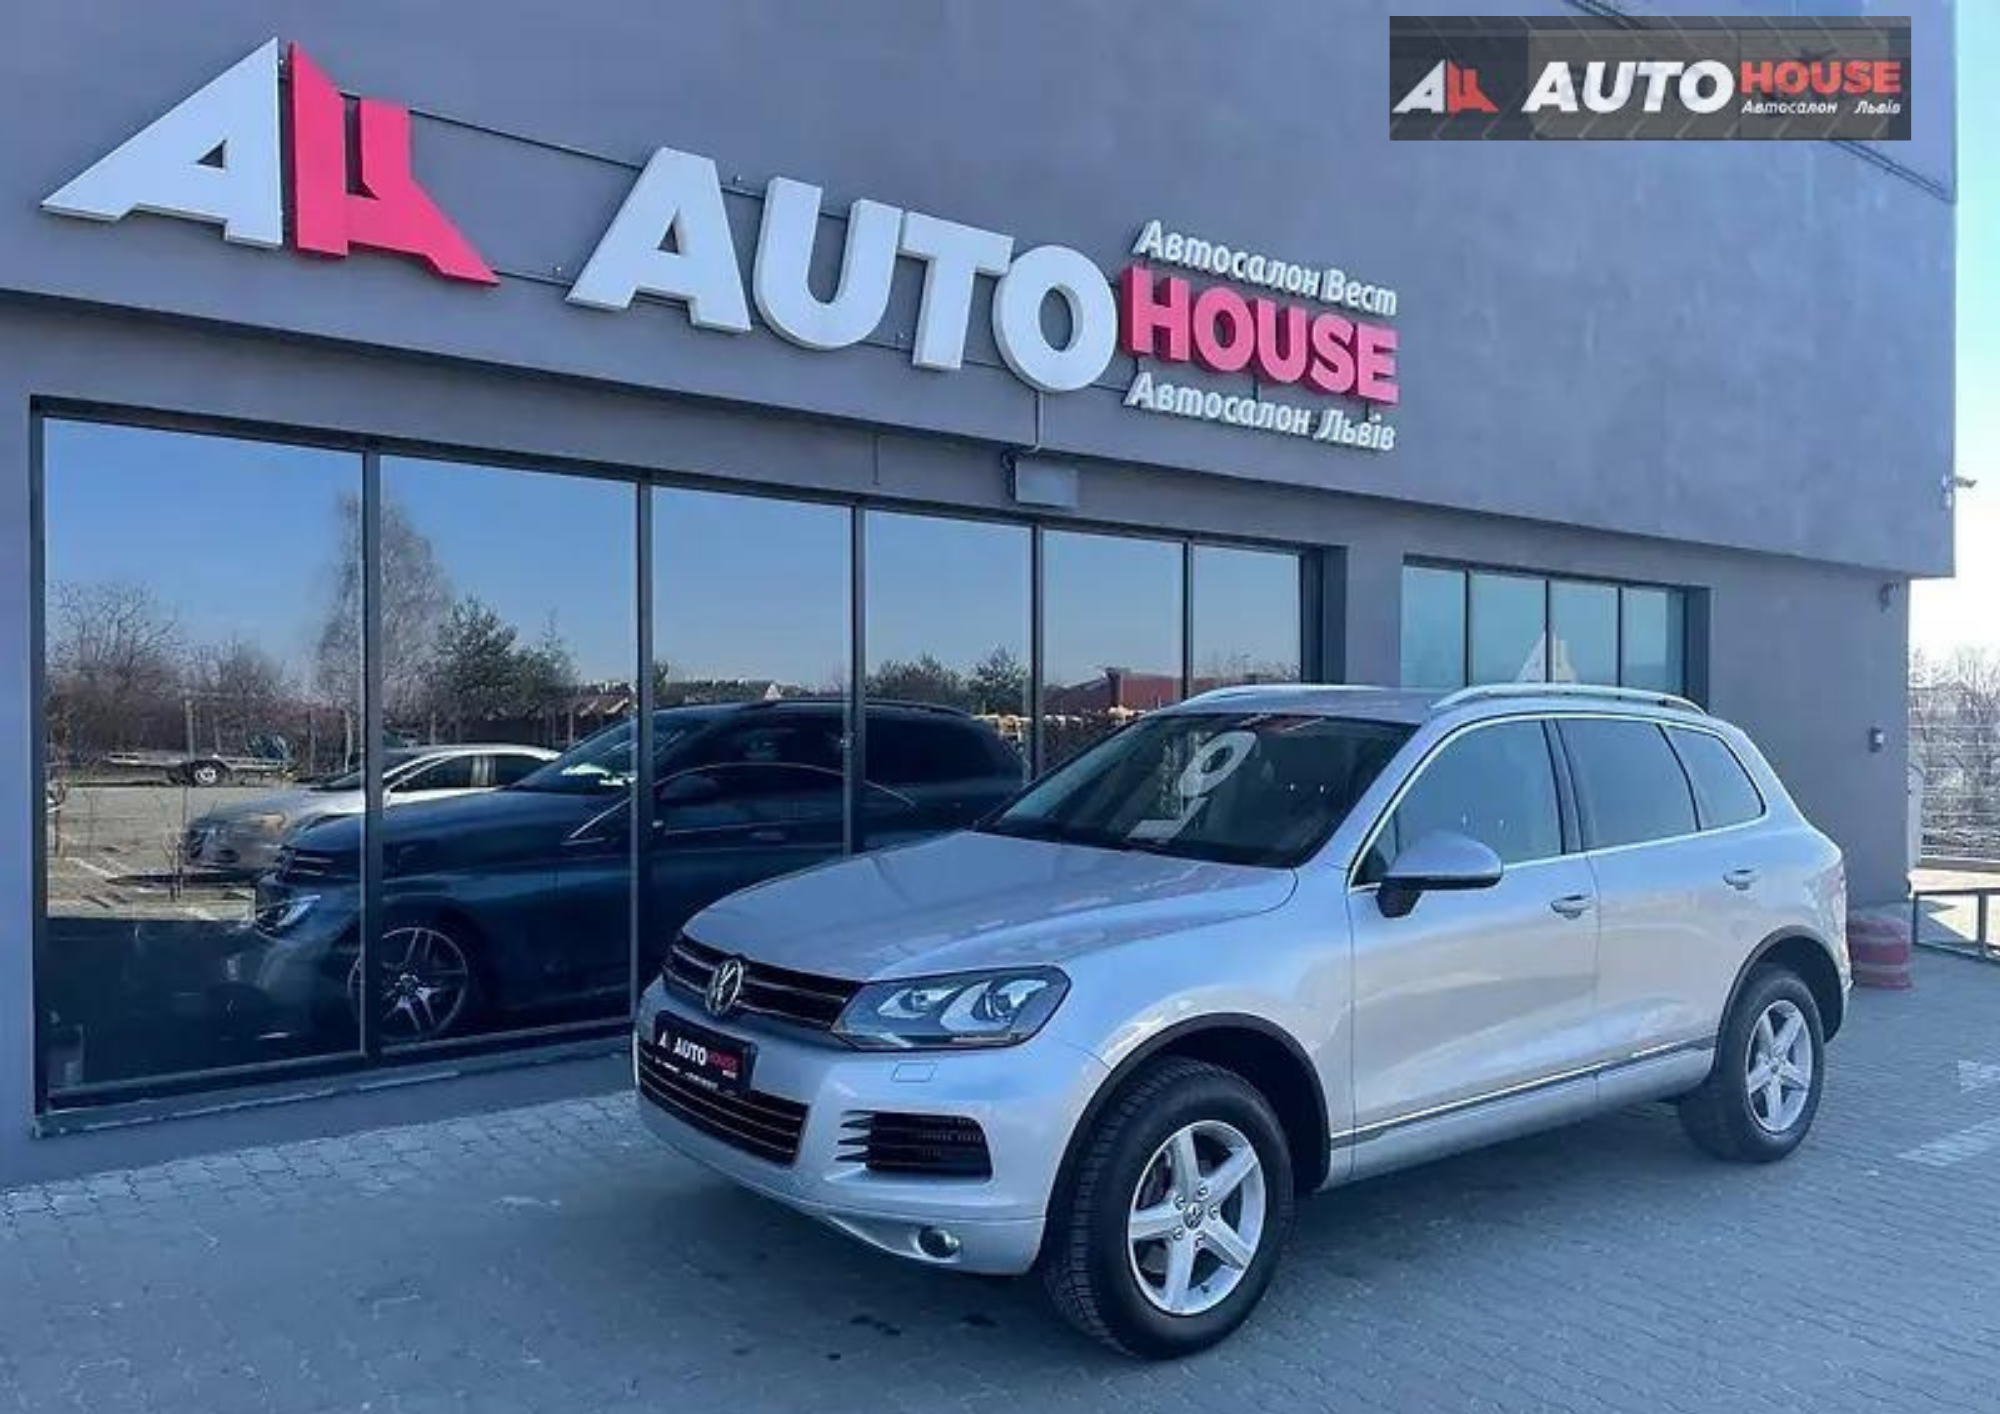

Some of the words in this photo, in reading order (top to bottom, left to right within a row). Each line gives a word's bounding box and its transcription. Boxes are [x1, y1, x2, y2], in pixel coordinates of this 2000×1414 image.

[565, 146, 1118, 392] AUTO
[1133, 219, 1321, 299] Автосалон
[1320, 268, 1397, 316] Вест
[1123, 264, 1400, 404] HOUSE
[1123, 371, 1311, 437] Автосалон
[1312, 409, 1397, 451] Львів
[673, 1036, 707, 1067] AUTO
